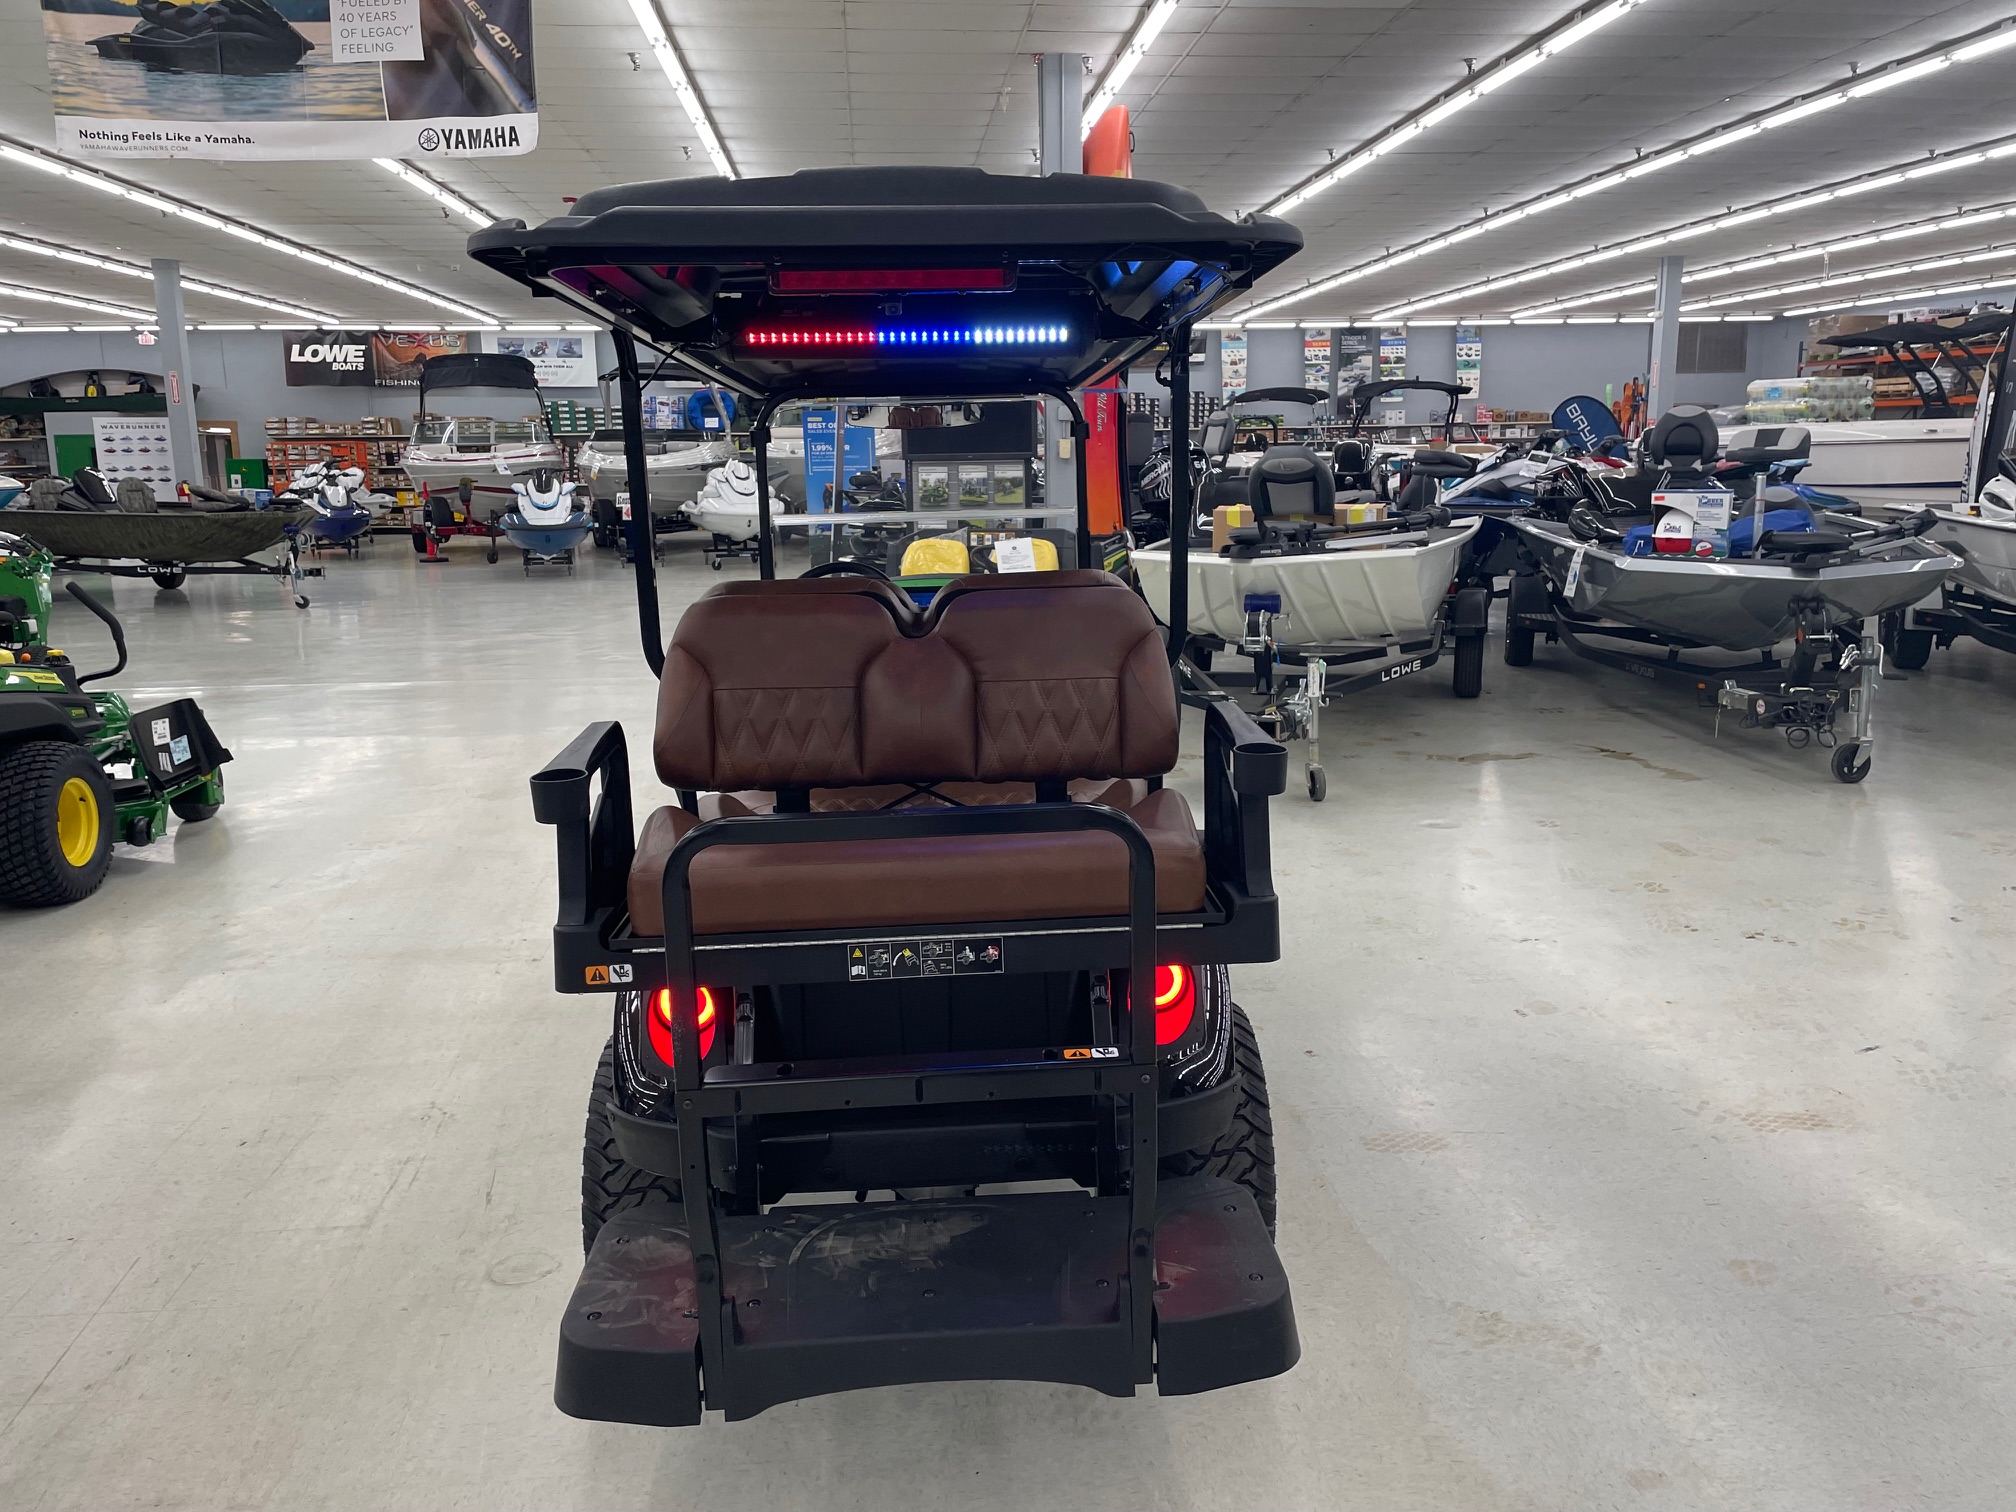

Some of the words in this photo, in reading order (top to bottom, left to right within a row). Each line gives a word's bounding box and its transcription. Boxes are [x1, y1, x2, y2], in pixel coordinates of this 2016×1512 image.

[339, 13, 355, 23] 40
[357, 11, 397, 22] YEARS
[463, 0, 487, 21] ER
[340, 28, 357, 39] OF
[79, 129, 129, 143] Nothing
[132, 131, 162, 141] Feels
[165, 132, 191, 142] Like
[204, 134, 256, 144] Yamaha.
[441, 126, 520, 149] YAMAHA
[80, 143, 189, 151] YAMAHAWAVERUNNERS.COM
[377, 332, 461, 349] VEXUS
[290, 344, 365, 362] LOWE
[332, 363, 364, 371] BOATS
[137, 566, 183, 574] LOWE
[1381, 659, 1422, 682] LOWE
